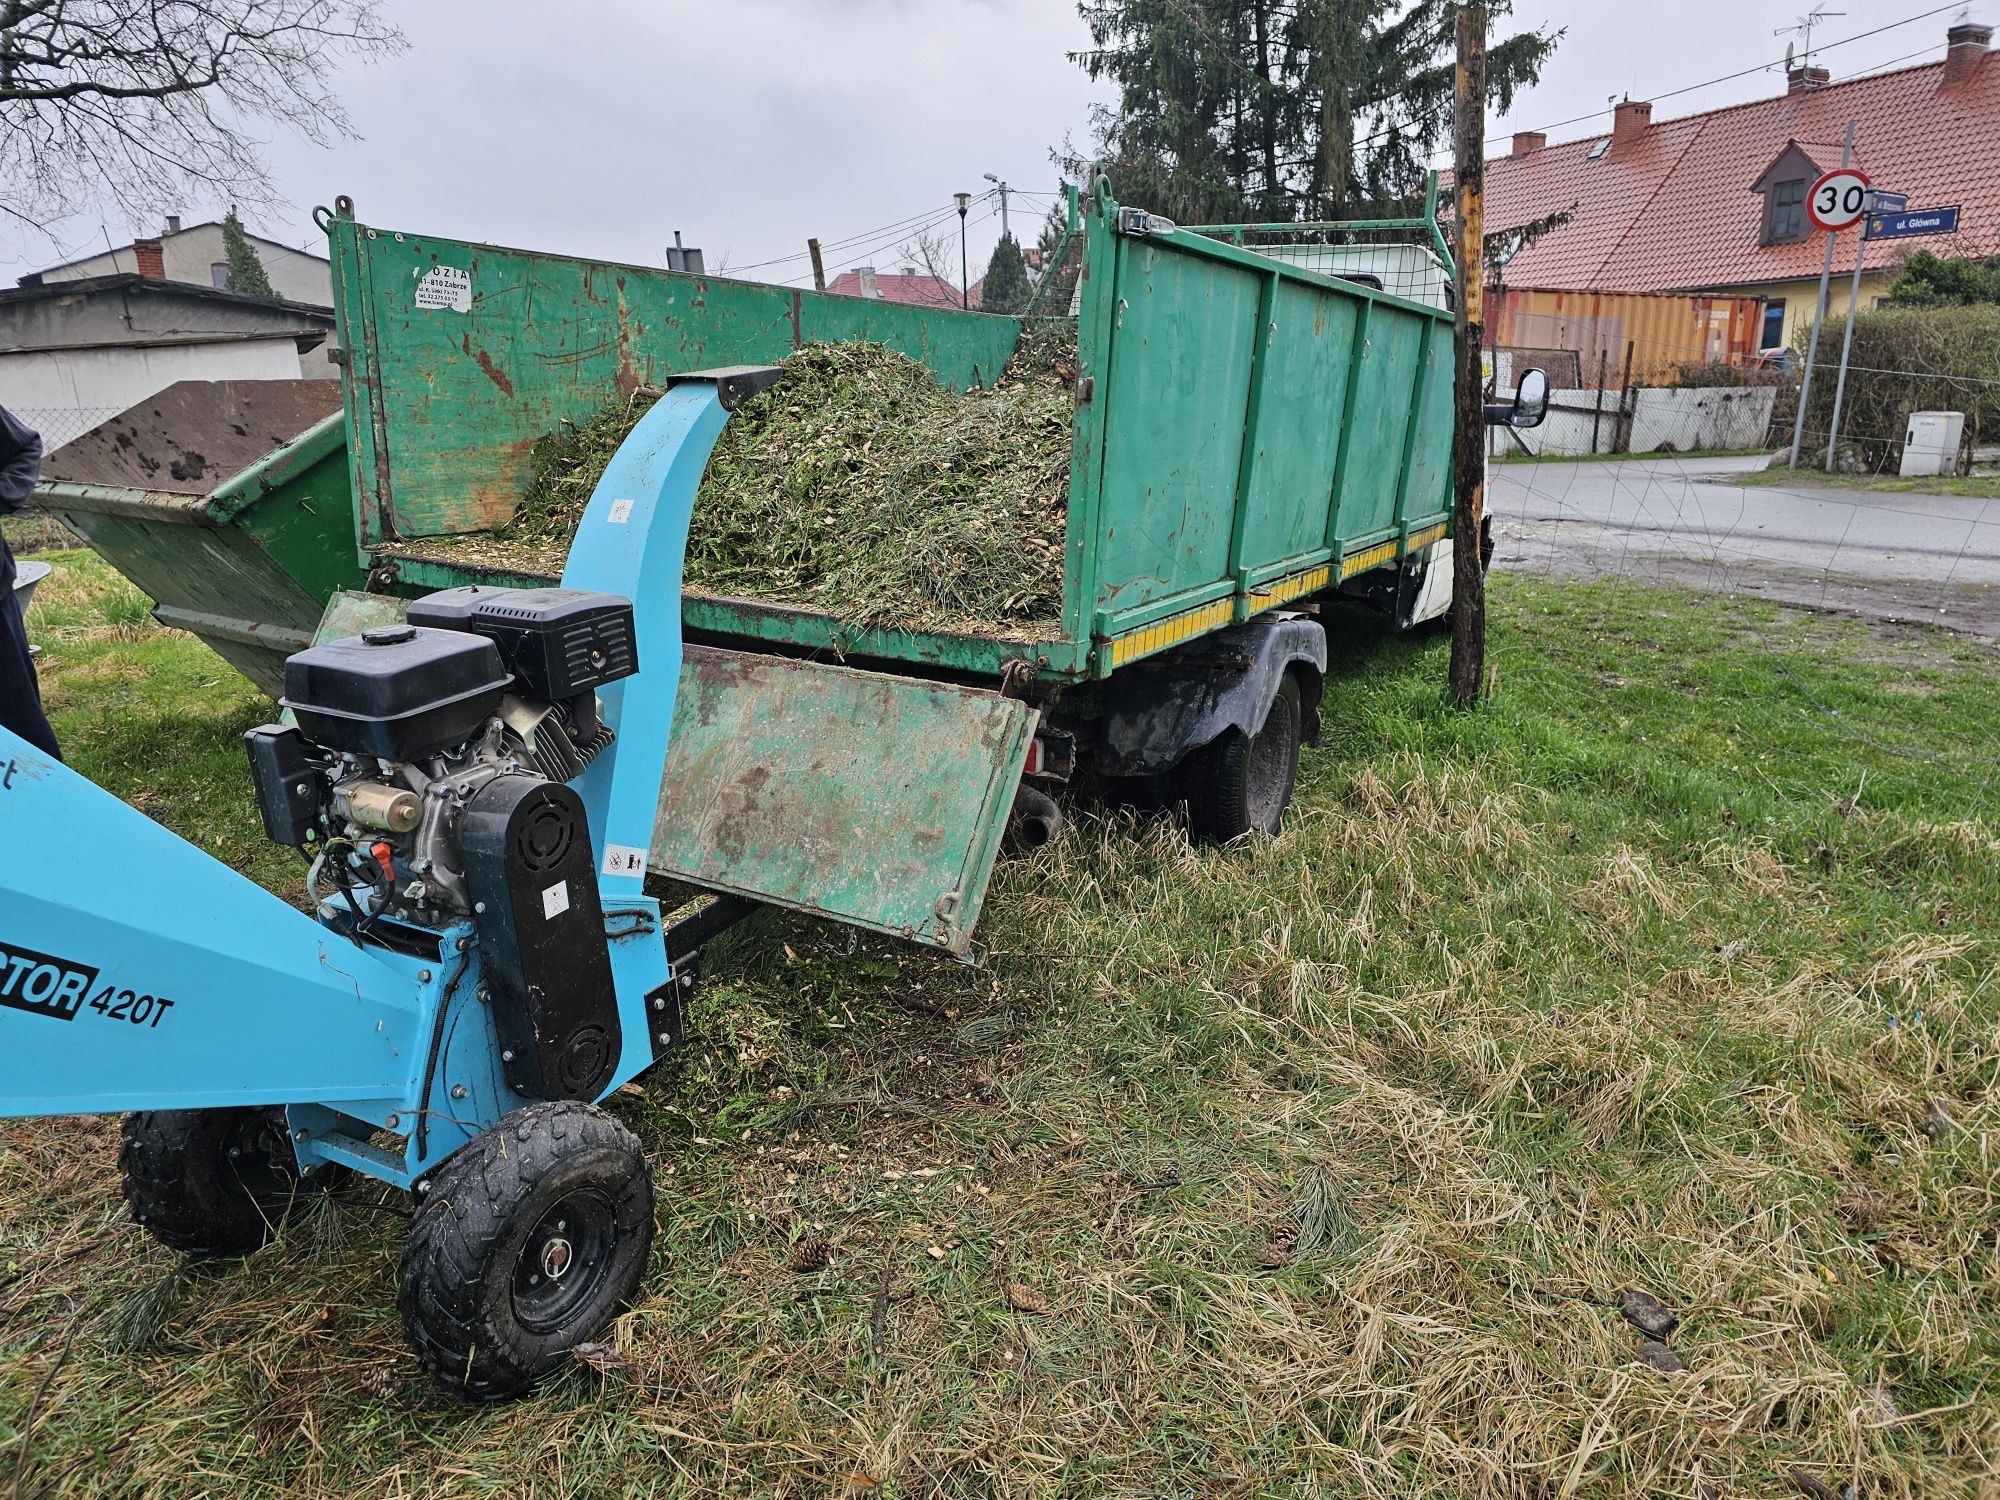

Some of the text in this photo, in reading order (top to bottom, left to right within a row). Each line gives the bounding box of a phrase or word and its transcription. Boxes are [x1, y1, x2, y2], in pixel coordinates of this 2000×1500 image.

[1817, 186, 1863, 214] 30
[1896, 218, 1940, 229] ul. Główna
[444, 280, 467, 290] Zabrze
[89, 986, 174, 1028] 420T
